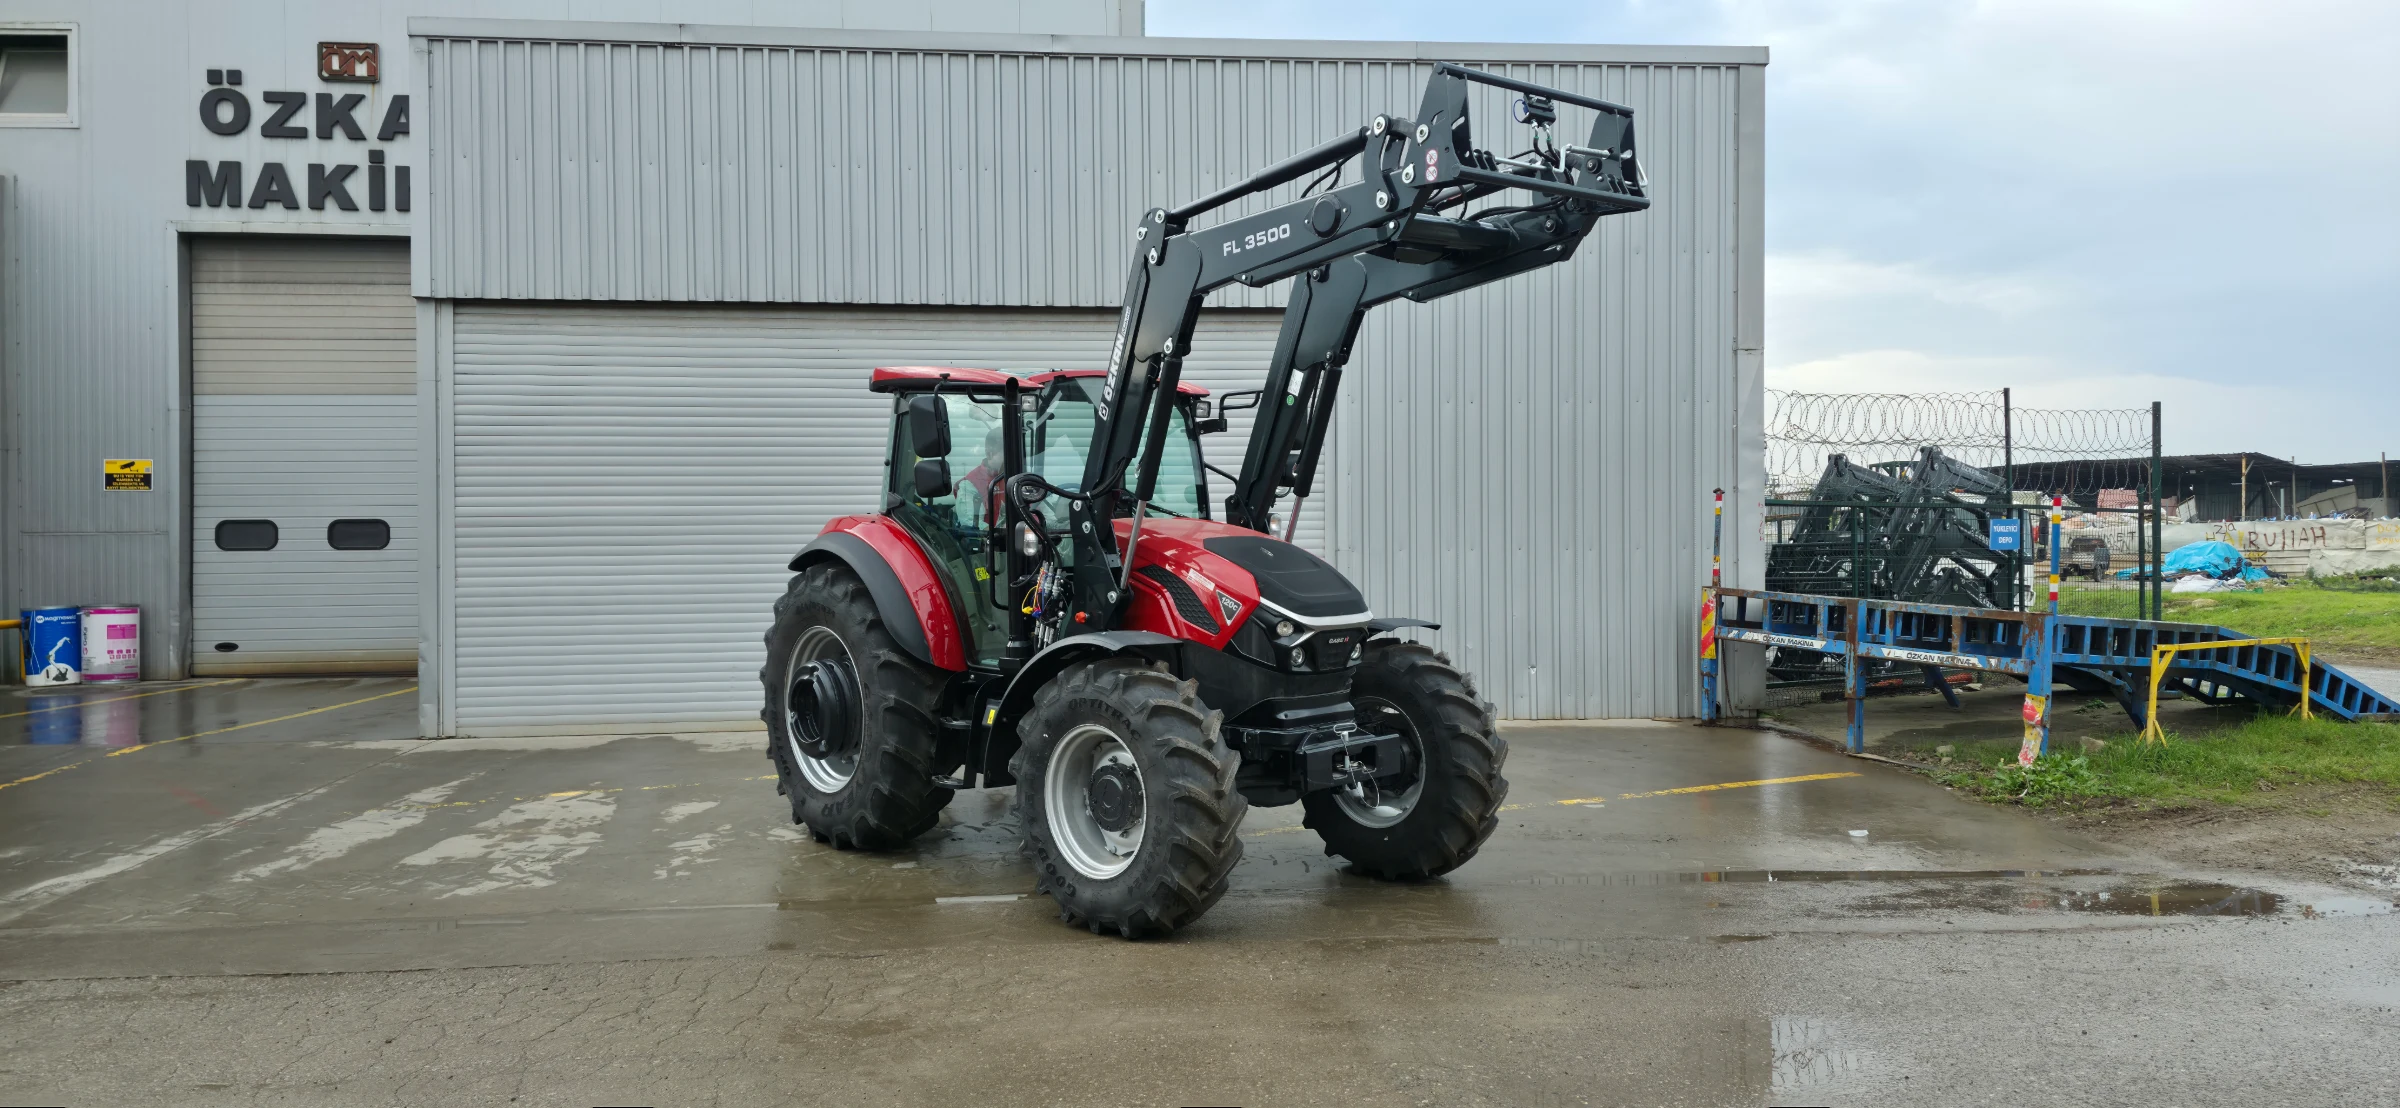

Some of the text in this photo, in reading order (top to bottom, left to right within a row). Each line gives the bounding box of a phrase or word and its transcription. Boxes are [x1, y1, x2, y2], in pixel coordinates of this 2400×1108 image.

[185, 149, 411, 212] MAKİ
[1223, 223, 1290, 256] FL 3500
[1998, 536, 2012, 544] DEPO
